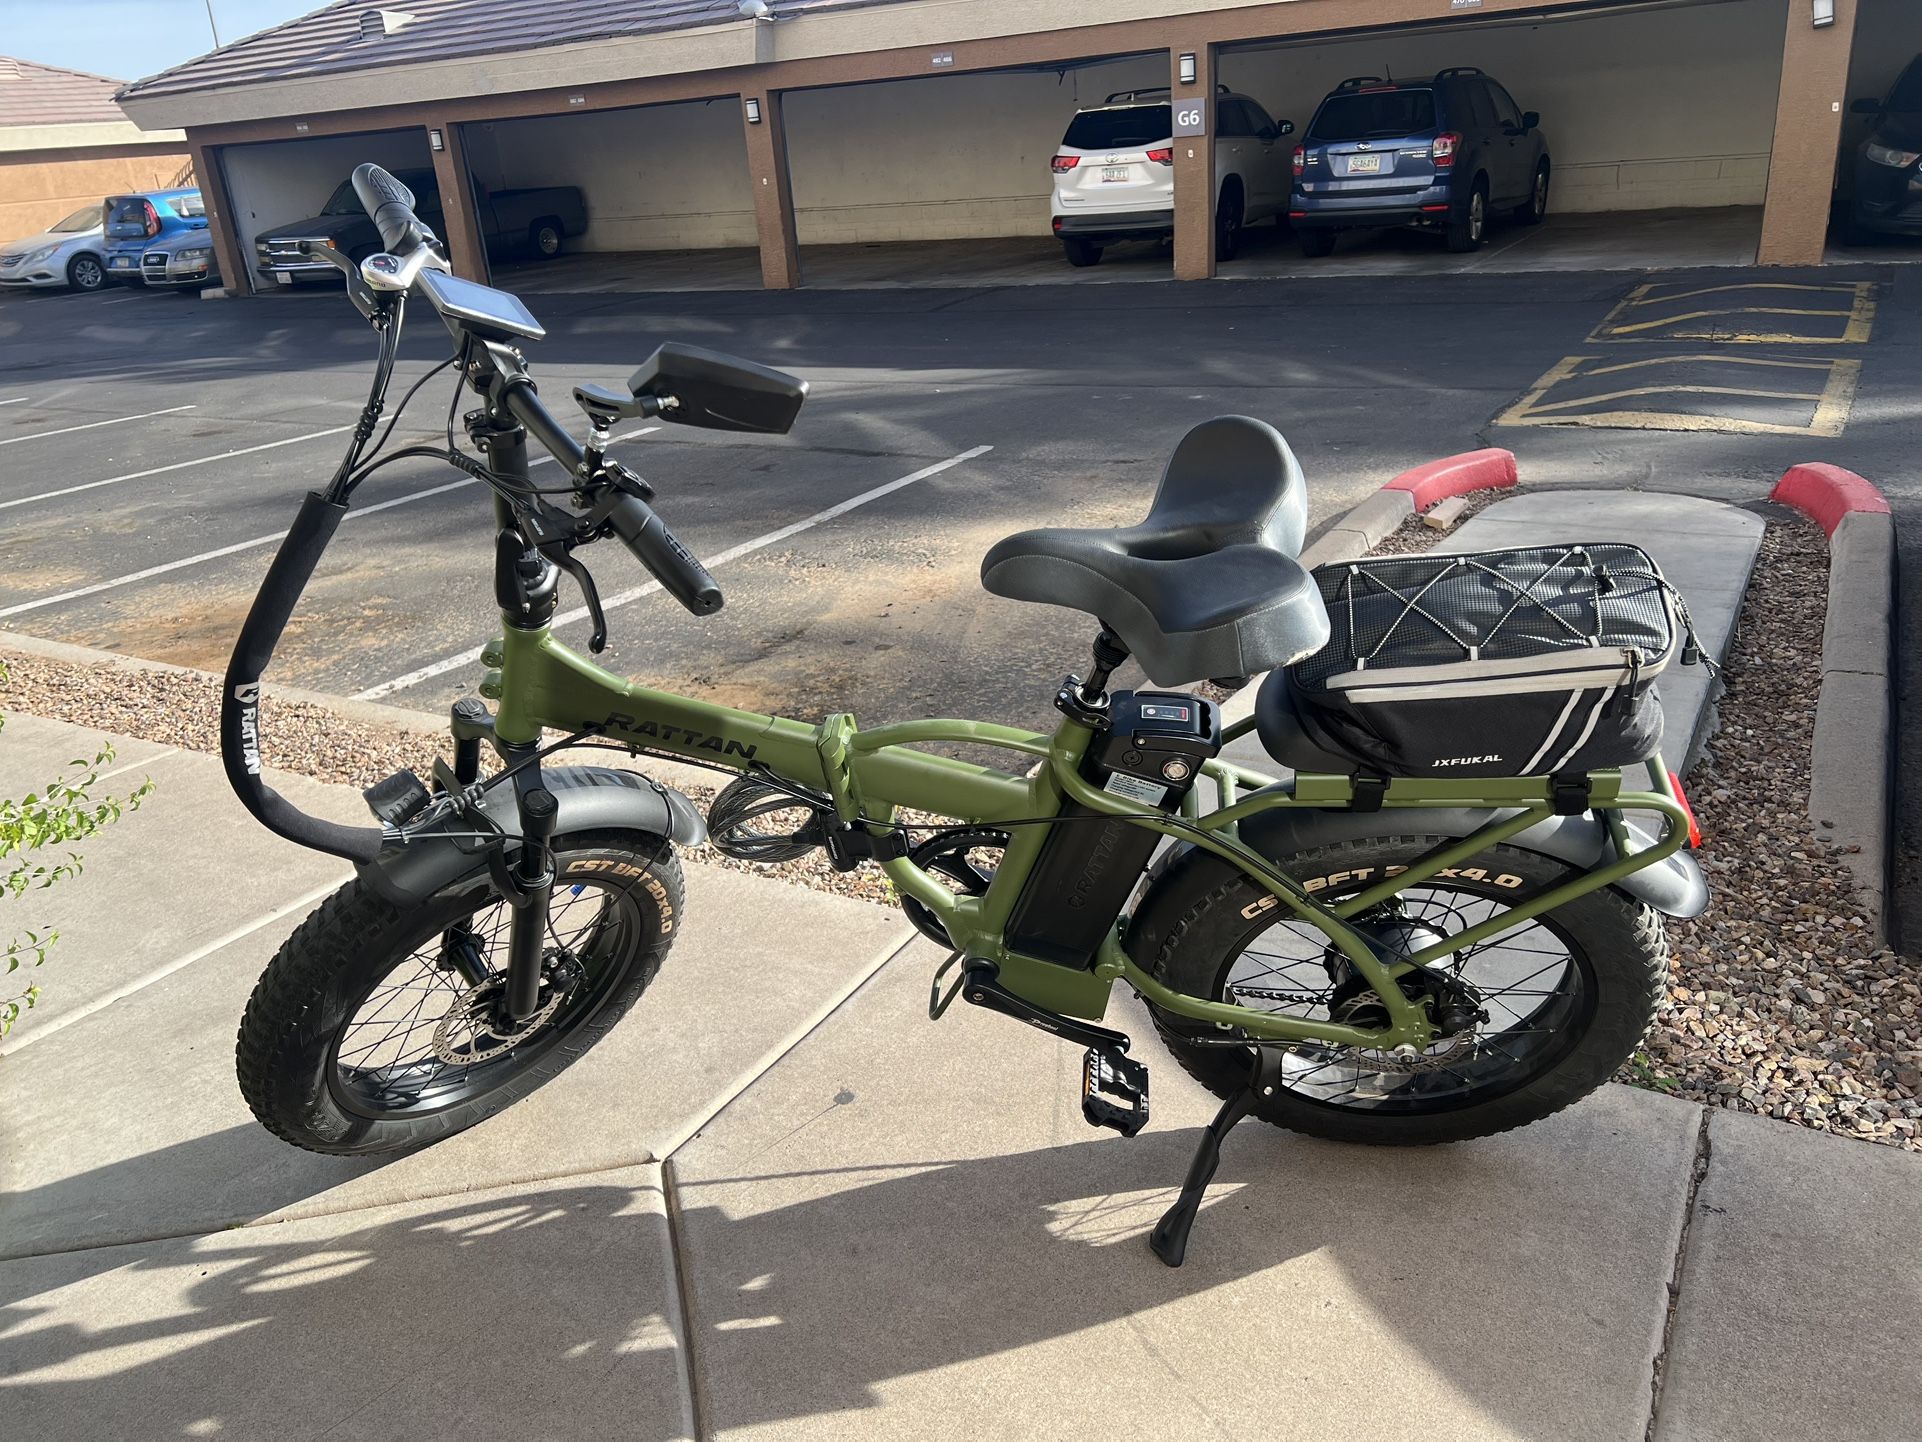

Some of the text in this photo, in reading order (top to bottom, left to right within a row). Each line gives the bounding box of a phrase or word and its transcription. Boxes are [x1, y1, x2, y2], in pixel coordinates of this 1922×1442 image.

[1178, 110, 1200, 126] G6
[242, 707, 260, 775] RATTAN
[604, 712, 757, 759] RATTAN
[1432, 754, 1503, 767] JXFUKAL
[565, 859, 615, 873] CST
[1302, 867, 1375, 893] BFT
[1384, 865, 1523, 888] 2x4.0
